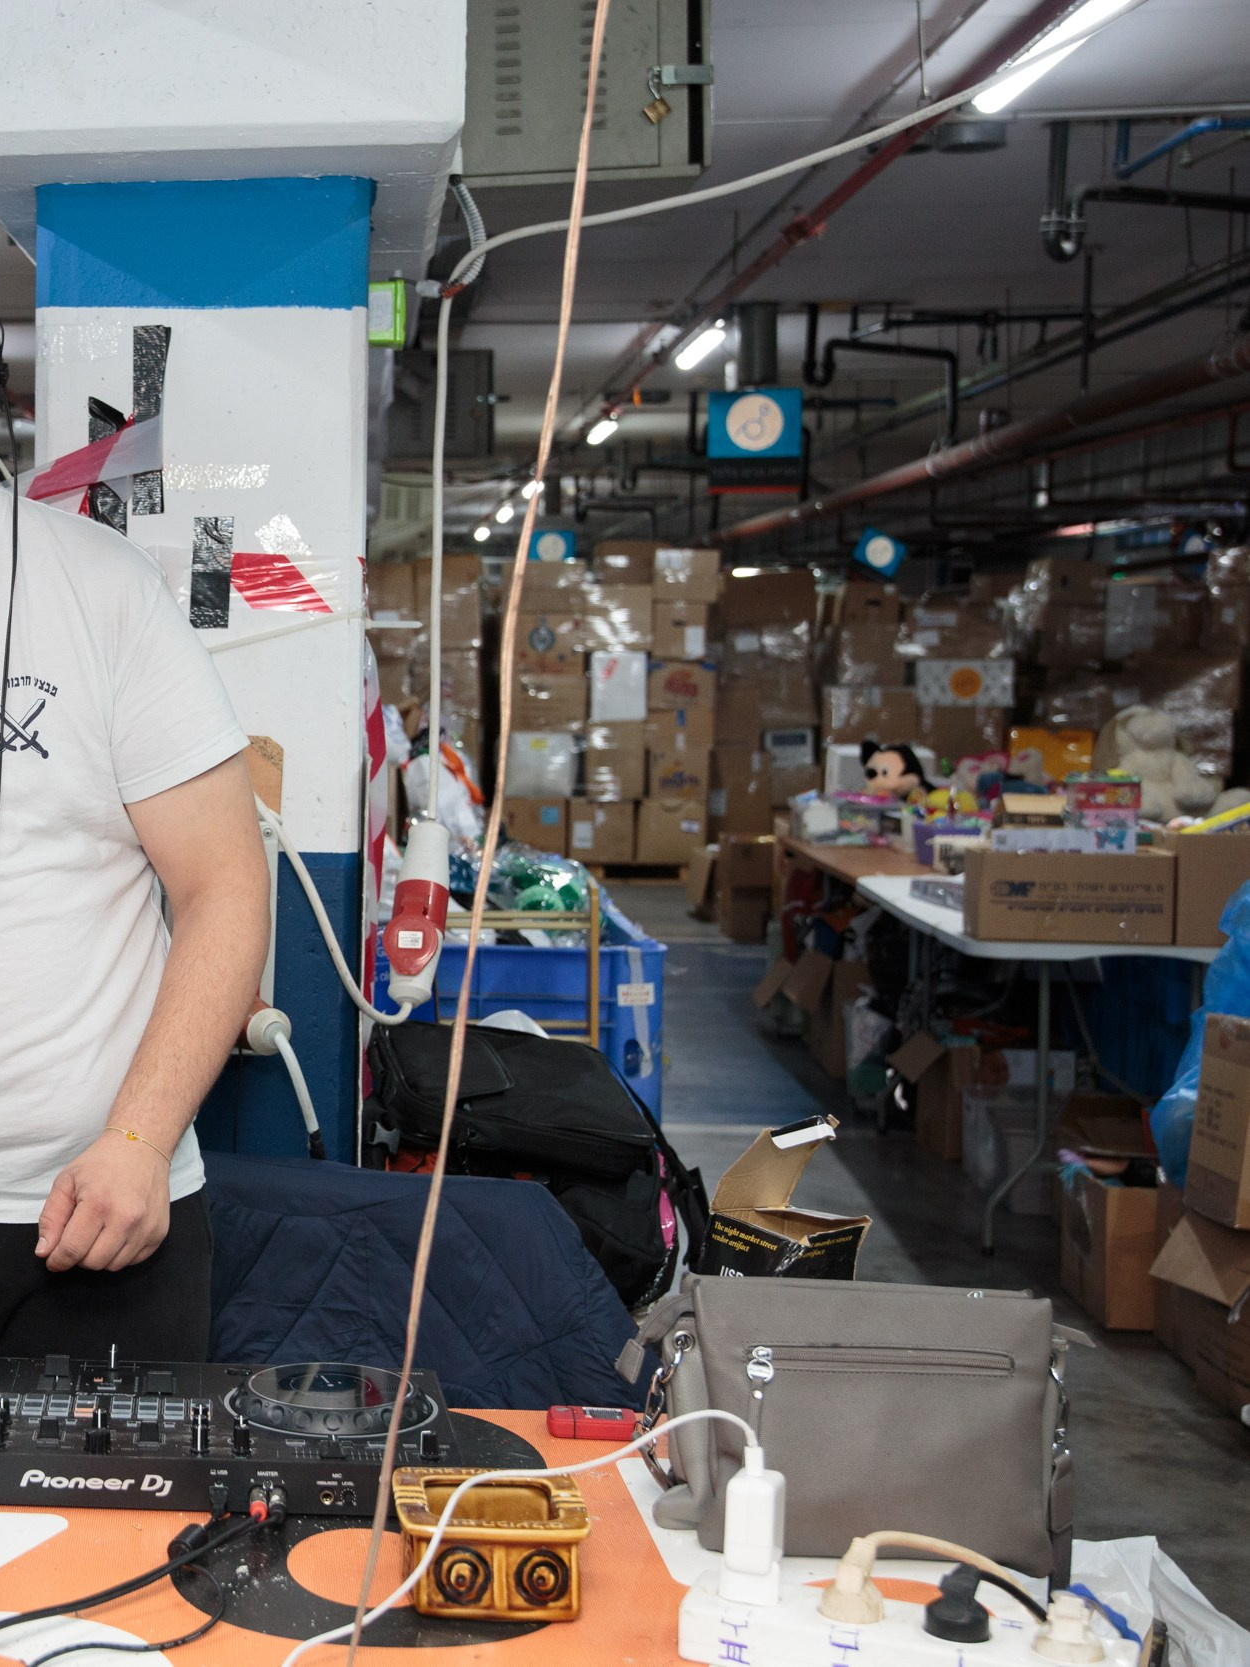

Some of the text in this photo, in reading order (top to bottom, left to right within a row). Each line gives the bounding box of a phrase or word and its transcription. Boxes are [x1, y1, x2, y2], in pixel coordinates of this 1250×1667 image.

[33, 677, 58, 697] מבצע
[713, 1221, 778, 1251] The night market street
[20, 1469, 135, 1491] Pioneer
